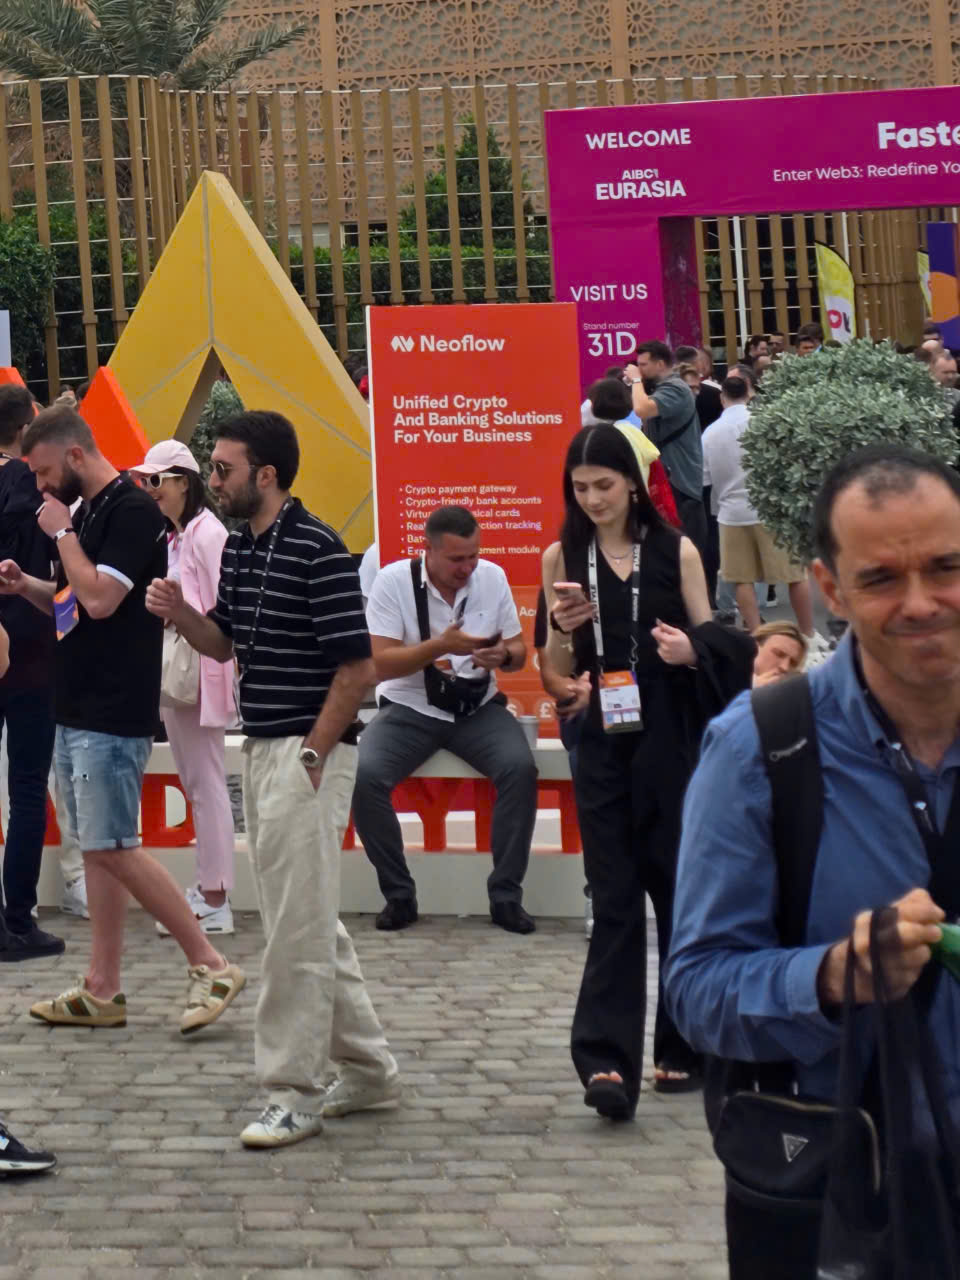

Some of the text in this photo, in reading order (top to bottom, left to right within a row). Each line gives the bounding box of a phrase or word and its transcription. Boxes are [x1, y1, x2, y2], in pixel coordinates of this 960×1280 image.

[585, 128, 691, 150] WELCOME
[773, 161, 960, 182] Enter Web3: Redefine Yo
[595, 179, 687, 200] EURASIA
[570, 283, 648, 302] VISIT US
[583, 322, 640, 331] Stand number
[420, 334, 506, 352] Neoflow
[587, 331, 637, 357] 31D
[393, 394, 508, 411] Unified Crypto
[393, 410, 563, 428] And Banking Solutions
[394, 428, 532, 444] For Your Business
[405, 484, 517, 495] Crypto payment gateway
[405, 496, 542, 507] Crypto-friendly bank accounts
[495, 509, 521, 517] cards
[505, 520, 542, 530] tracking
[508, 545, 541, 554] module
